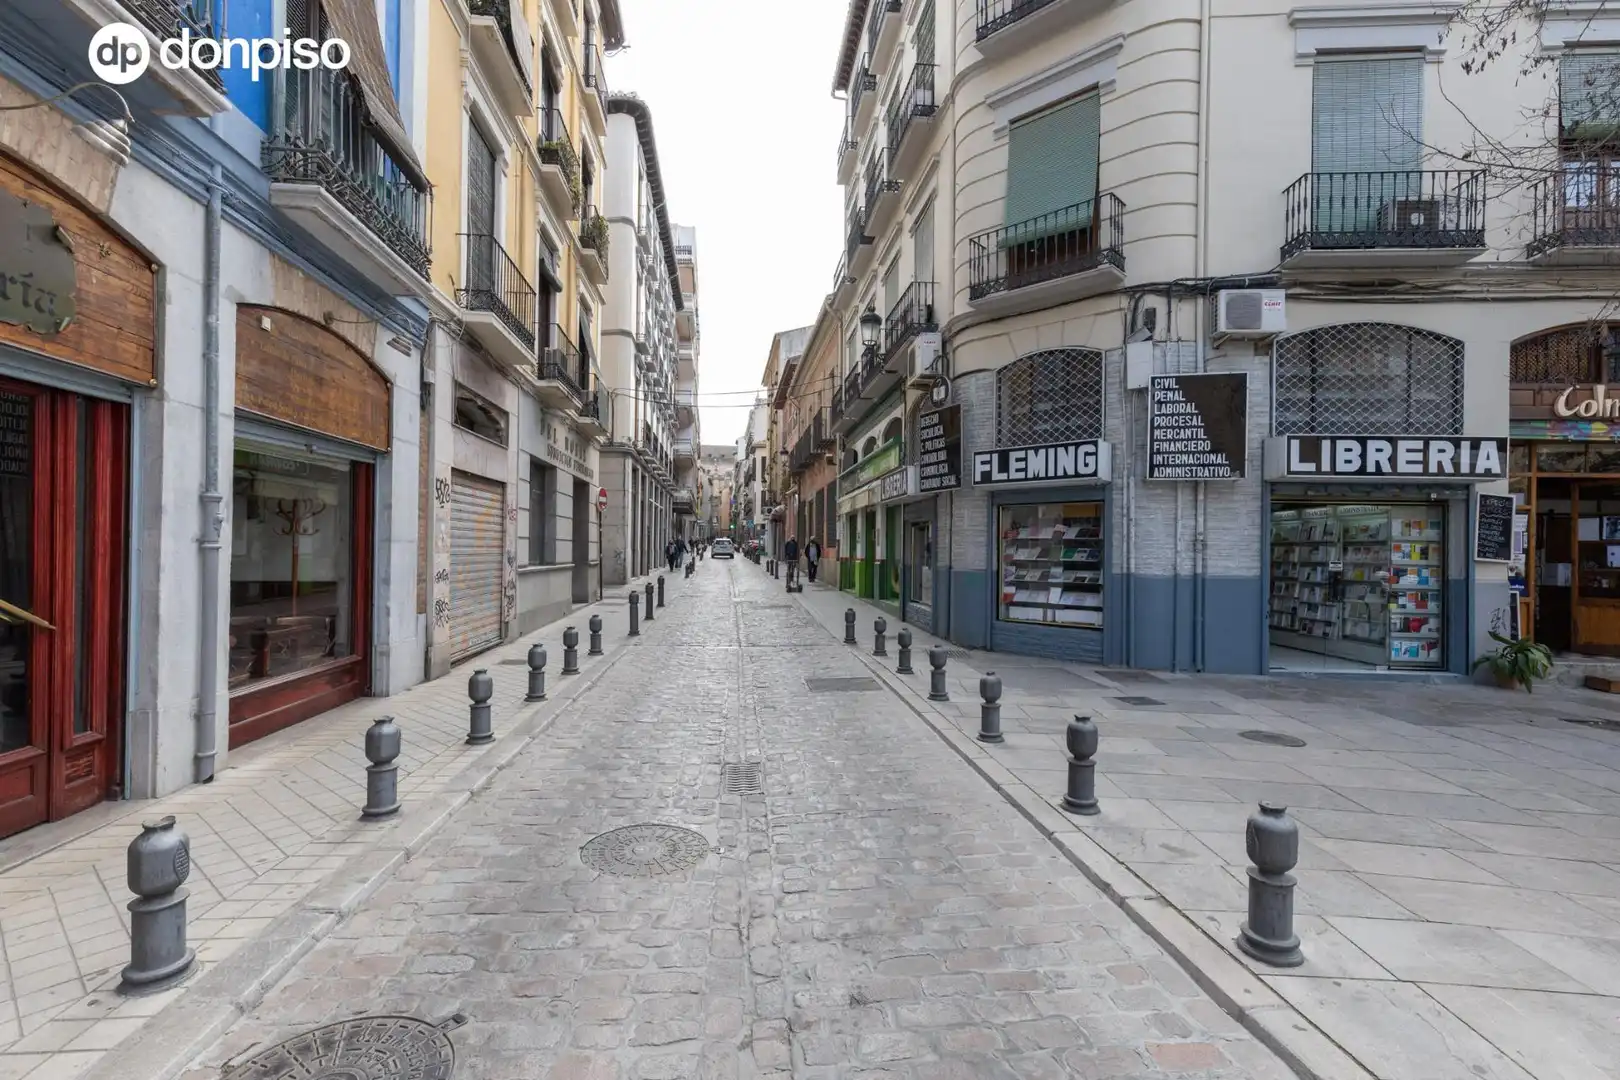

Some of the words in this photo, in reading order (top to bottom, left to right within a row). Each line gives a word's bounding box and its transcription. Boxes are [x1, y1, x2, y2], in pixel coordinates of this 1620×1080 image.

[1154, 378, 1179, 389] CIVIL
[1154, 390, 1186, 402] PENAL
[1154, 402, 1199, 414] LABORAL
[920, 413, 939, 427] DERECHO
[1153, 415, 1205, 427] PROCESAL
[1153, 428, 1208, 440] MERCANTIL
[1153, 440, 1211, 453] FINANCIERO
[974, 443, 1098, 482] FLEMING
[1153, 453, 1230, 465] INTERNACIONAL
[1289, 439, 1502, 475] LIBRERIA
[1153, 466, 1231, 478] ADMINISTRATIVO
[881, 470, 907, 500] LIBRERIA
